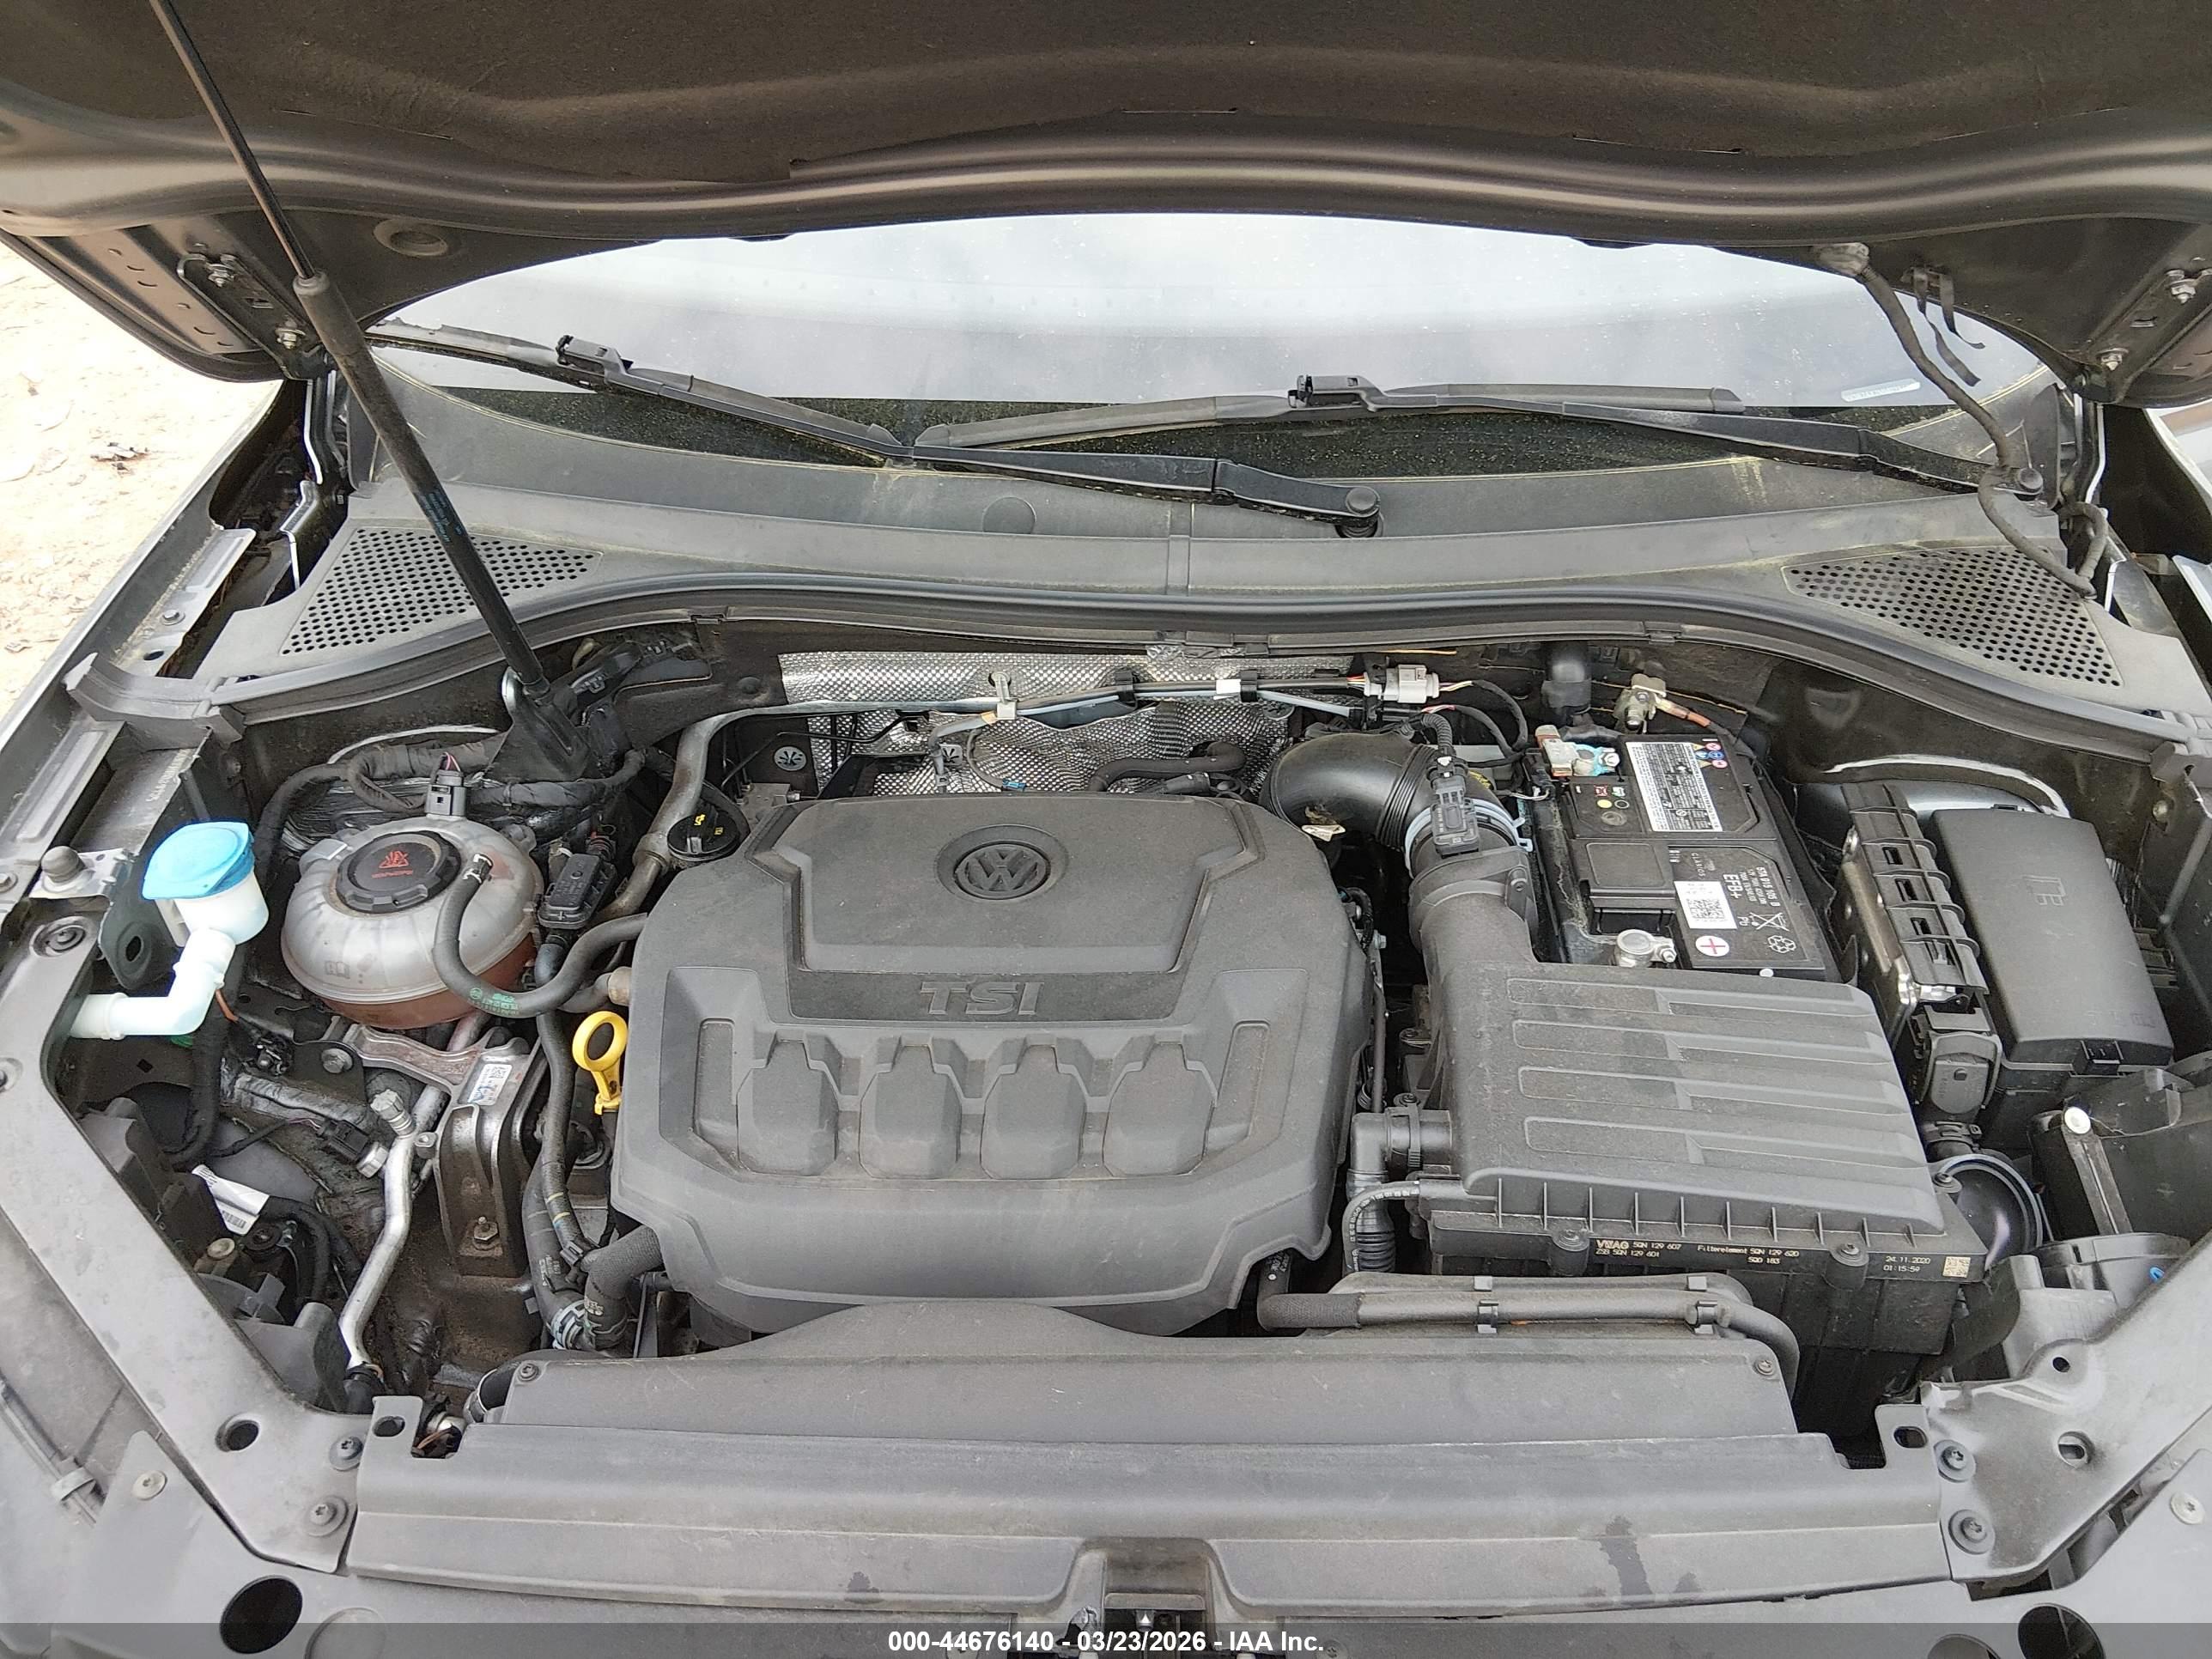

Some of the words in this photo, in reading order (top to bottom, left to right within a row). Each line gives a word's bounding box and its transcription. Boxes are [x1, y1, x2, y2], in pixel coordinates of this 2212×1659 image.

[954, 840, 1051, 900] VW
[1723, 874, 1744, 899] EFB+
[1737, 915, 1750, 927] Pb
[920, 981, 1045, 1016] TSI
[1697, 1244, 1747, 1254] Filterelement
